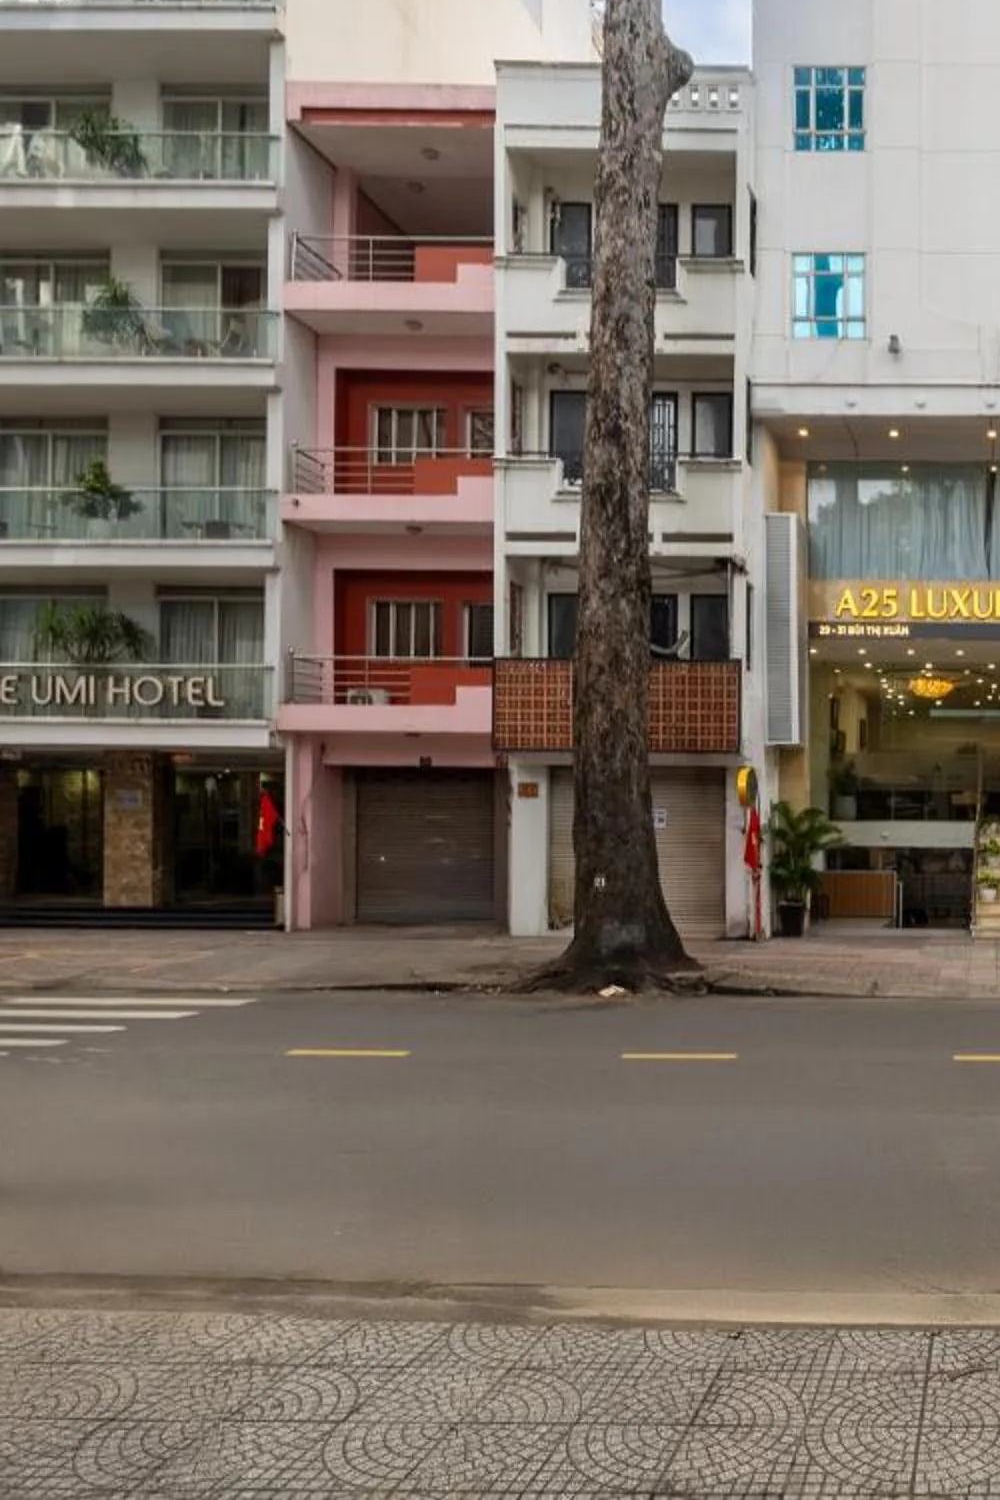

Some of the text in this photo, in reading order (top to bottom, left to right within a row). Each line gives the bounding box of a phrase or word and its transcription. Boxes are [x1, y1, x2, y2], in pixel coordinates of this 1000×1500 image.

[835, 588, 898, 618] A25
[31, 676, 95, 705] UMI
[108, 676, 224, 706] HOTEL
